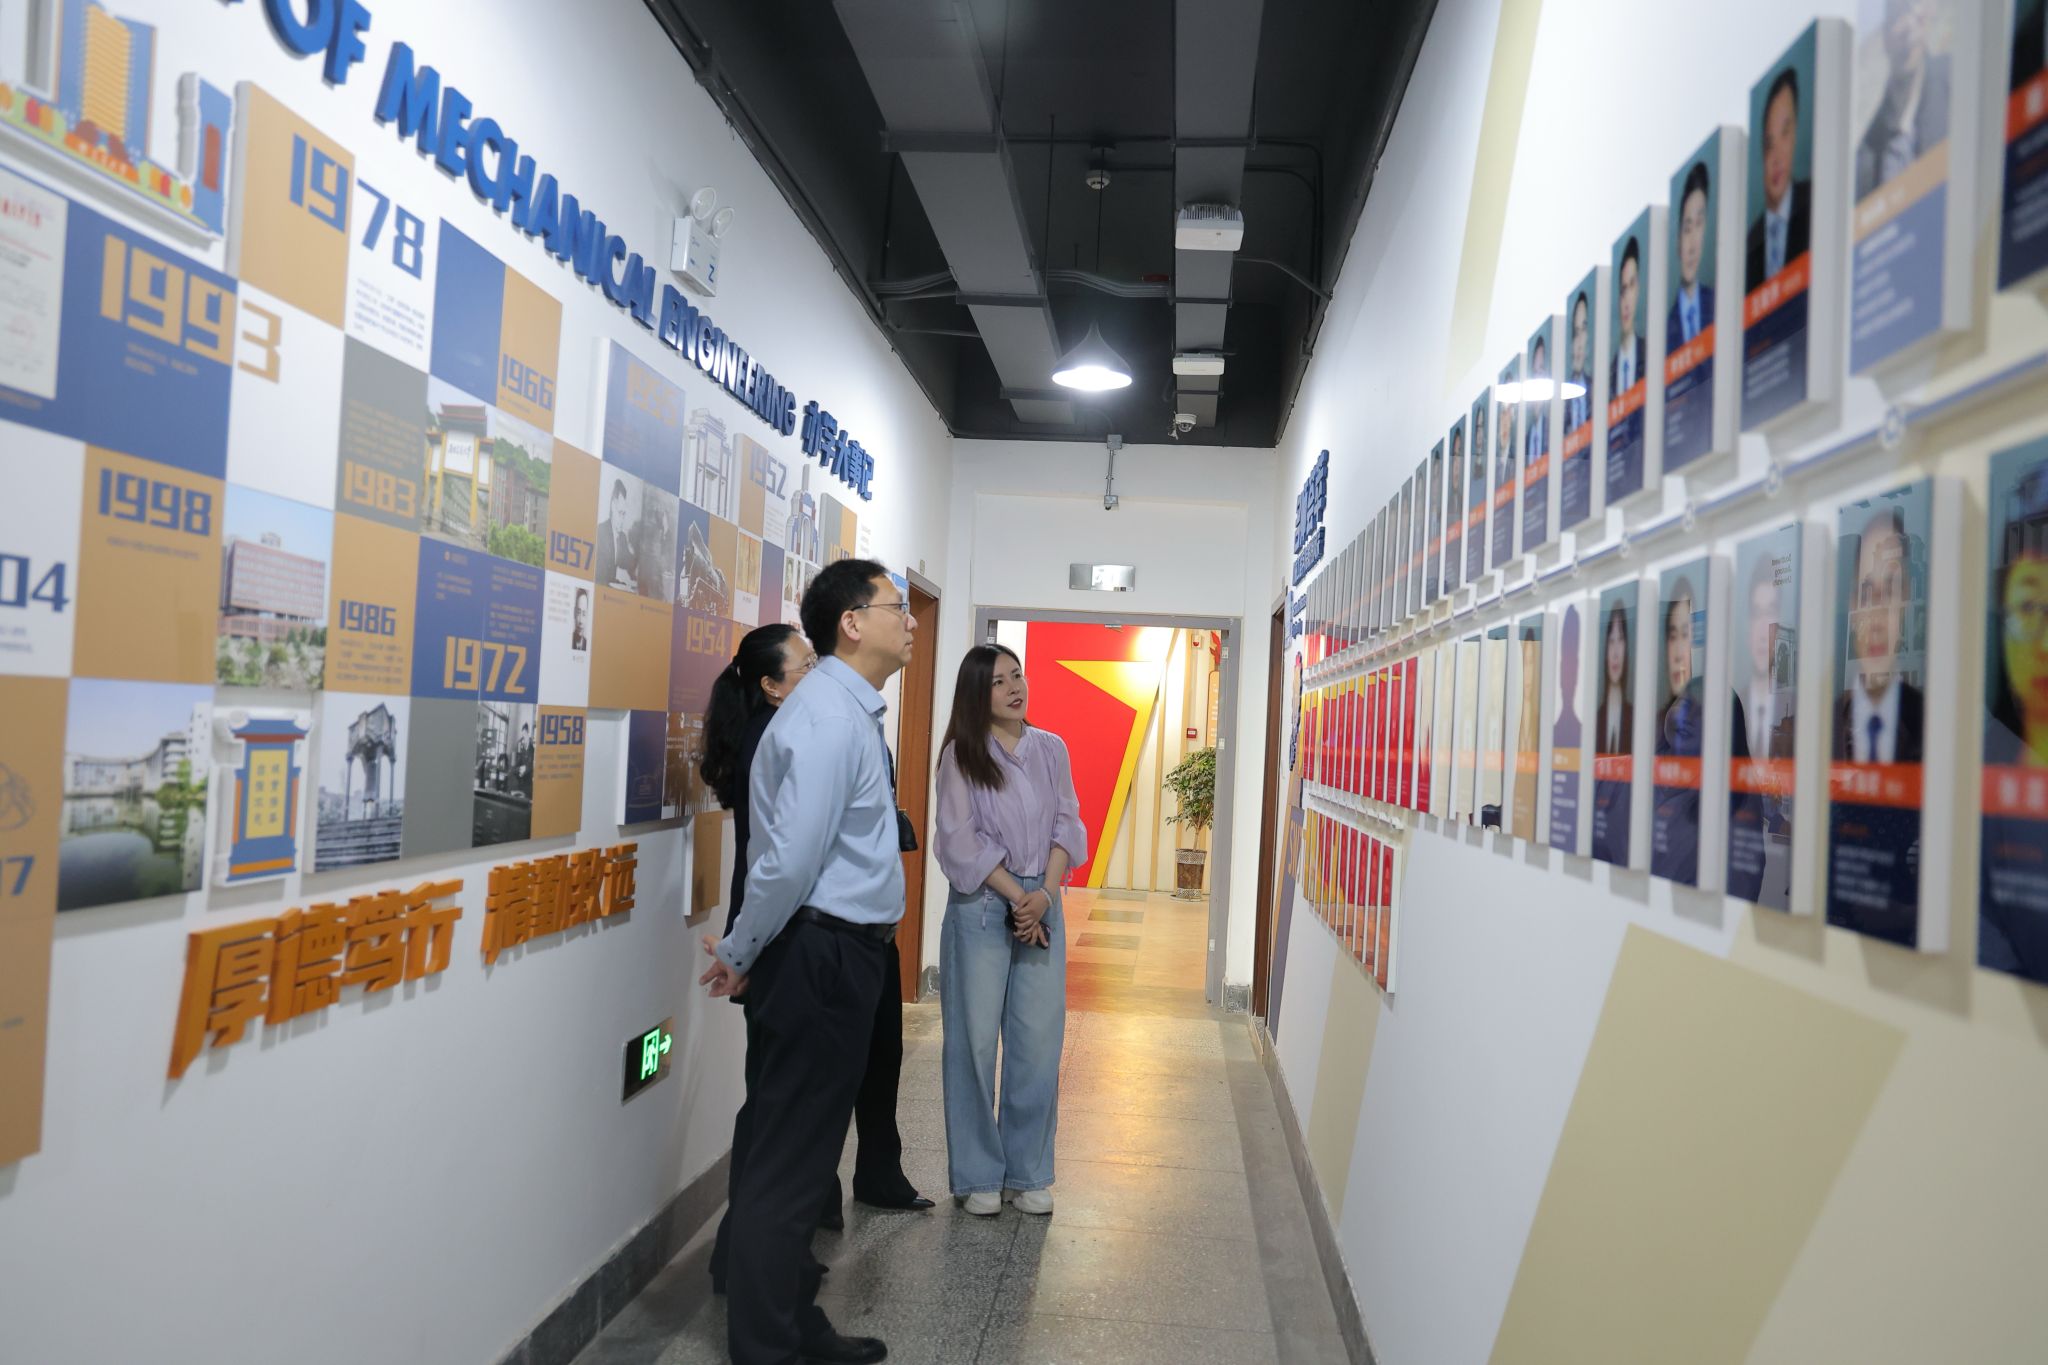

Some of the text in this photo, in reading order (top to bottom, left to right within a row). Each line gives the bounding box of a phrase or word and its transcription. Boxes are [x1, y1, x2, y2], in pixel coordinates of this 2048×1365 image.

[288, 133, 425, 281] 1978
[375, 41, 656, 332] MECHANICAL
[658, 284, 796, 437] ENGINEERING
[100, 233, 282, 384] 1993
[501, 352, 555, 412] 1966
[98, 467, 213, 538] 1998
[343, 459, 417, 520] 1983
[749, 446, 787, 501] 1952
[549, 530, 595, 571] 1957
[338, 599, 398, 637] 1986
[685, 614, 727, 658] 1954
[443, 635, 528, 695] 1972
[539, 714, 584, 746] 1958
[0, 854, 36, 897] 7
[166, 878, 464, 1080] 厚德笃行
